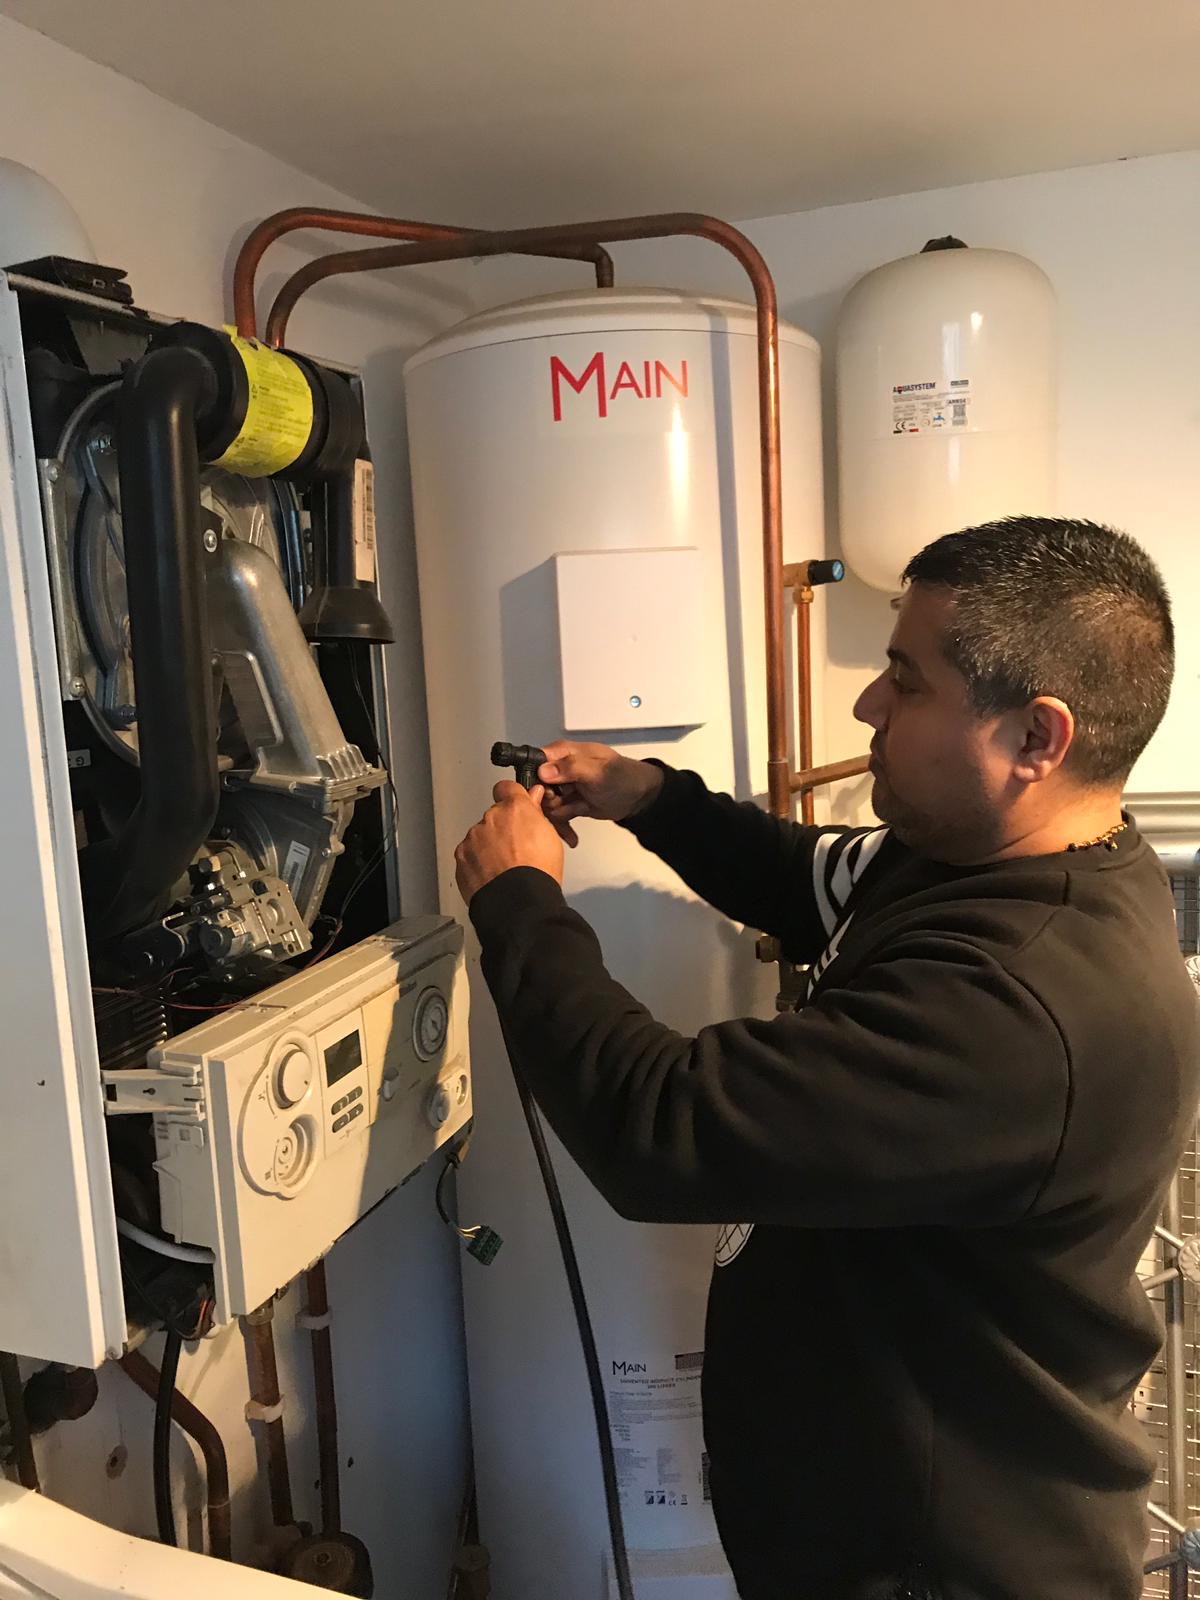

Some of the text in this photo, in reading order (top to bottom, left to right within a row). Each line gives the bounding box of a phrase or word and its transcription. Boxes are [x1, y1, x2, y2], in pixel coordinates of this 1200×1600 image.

[550, 352, 688, 421] MAIN
[892, 382, 936, 394] AQUASYSTEM
[612, 1360, 647, 1376] MAIN
